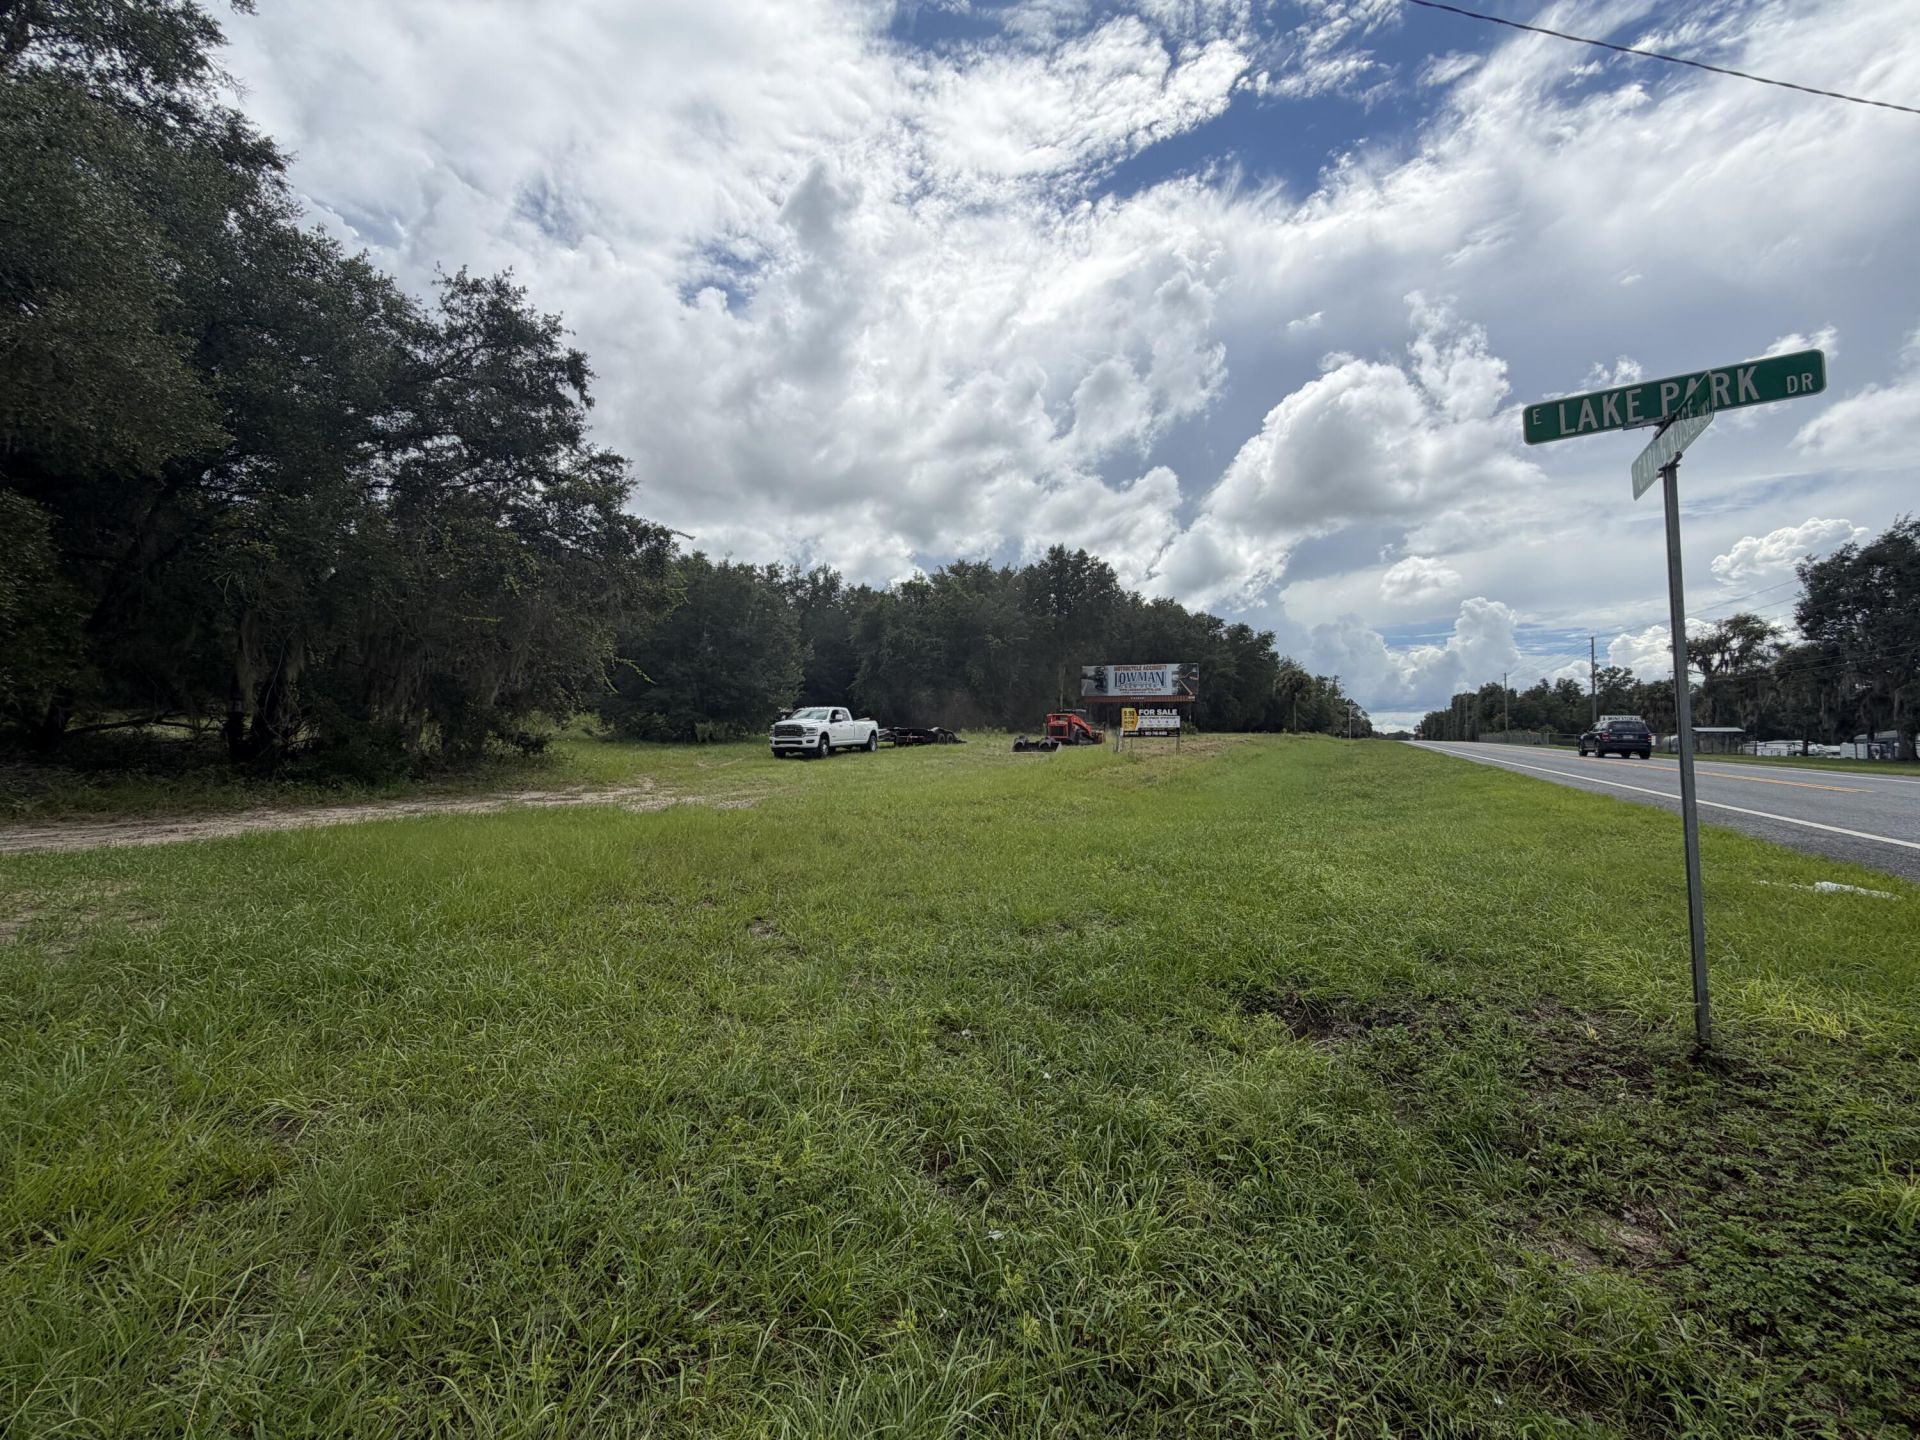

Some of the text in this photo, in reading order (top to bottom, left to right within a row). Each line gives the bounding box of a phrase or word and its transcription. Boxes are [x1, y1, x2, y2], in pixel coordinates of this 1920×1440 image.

[1532, 408, 1542, 425] E
[1559, 388, 1645, 435] LAKE
[1786, 372, 1814, 394] DR
[1114, 671, 1167, 688] LOWMAN
